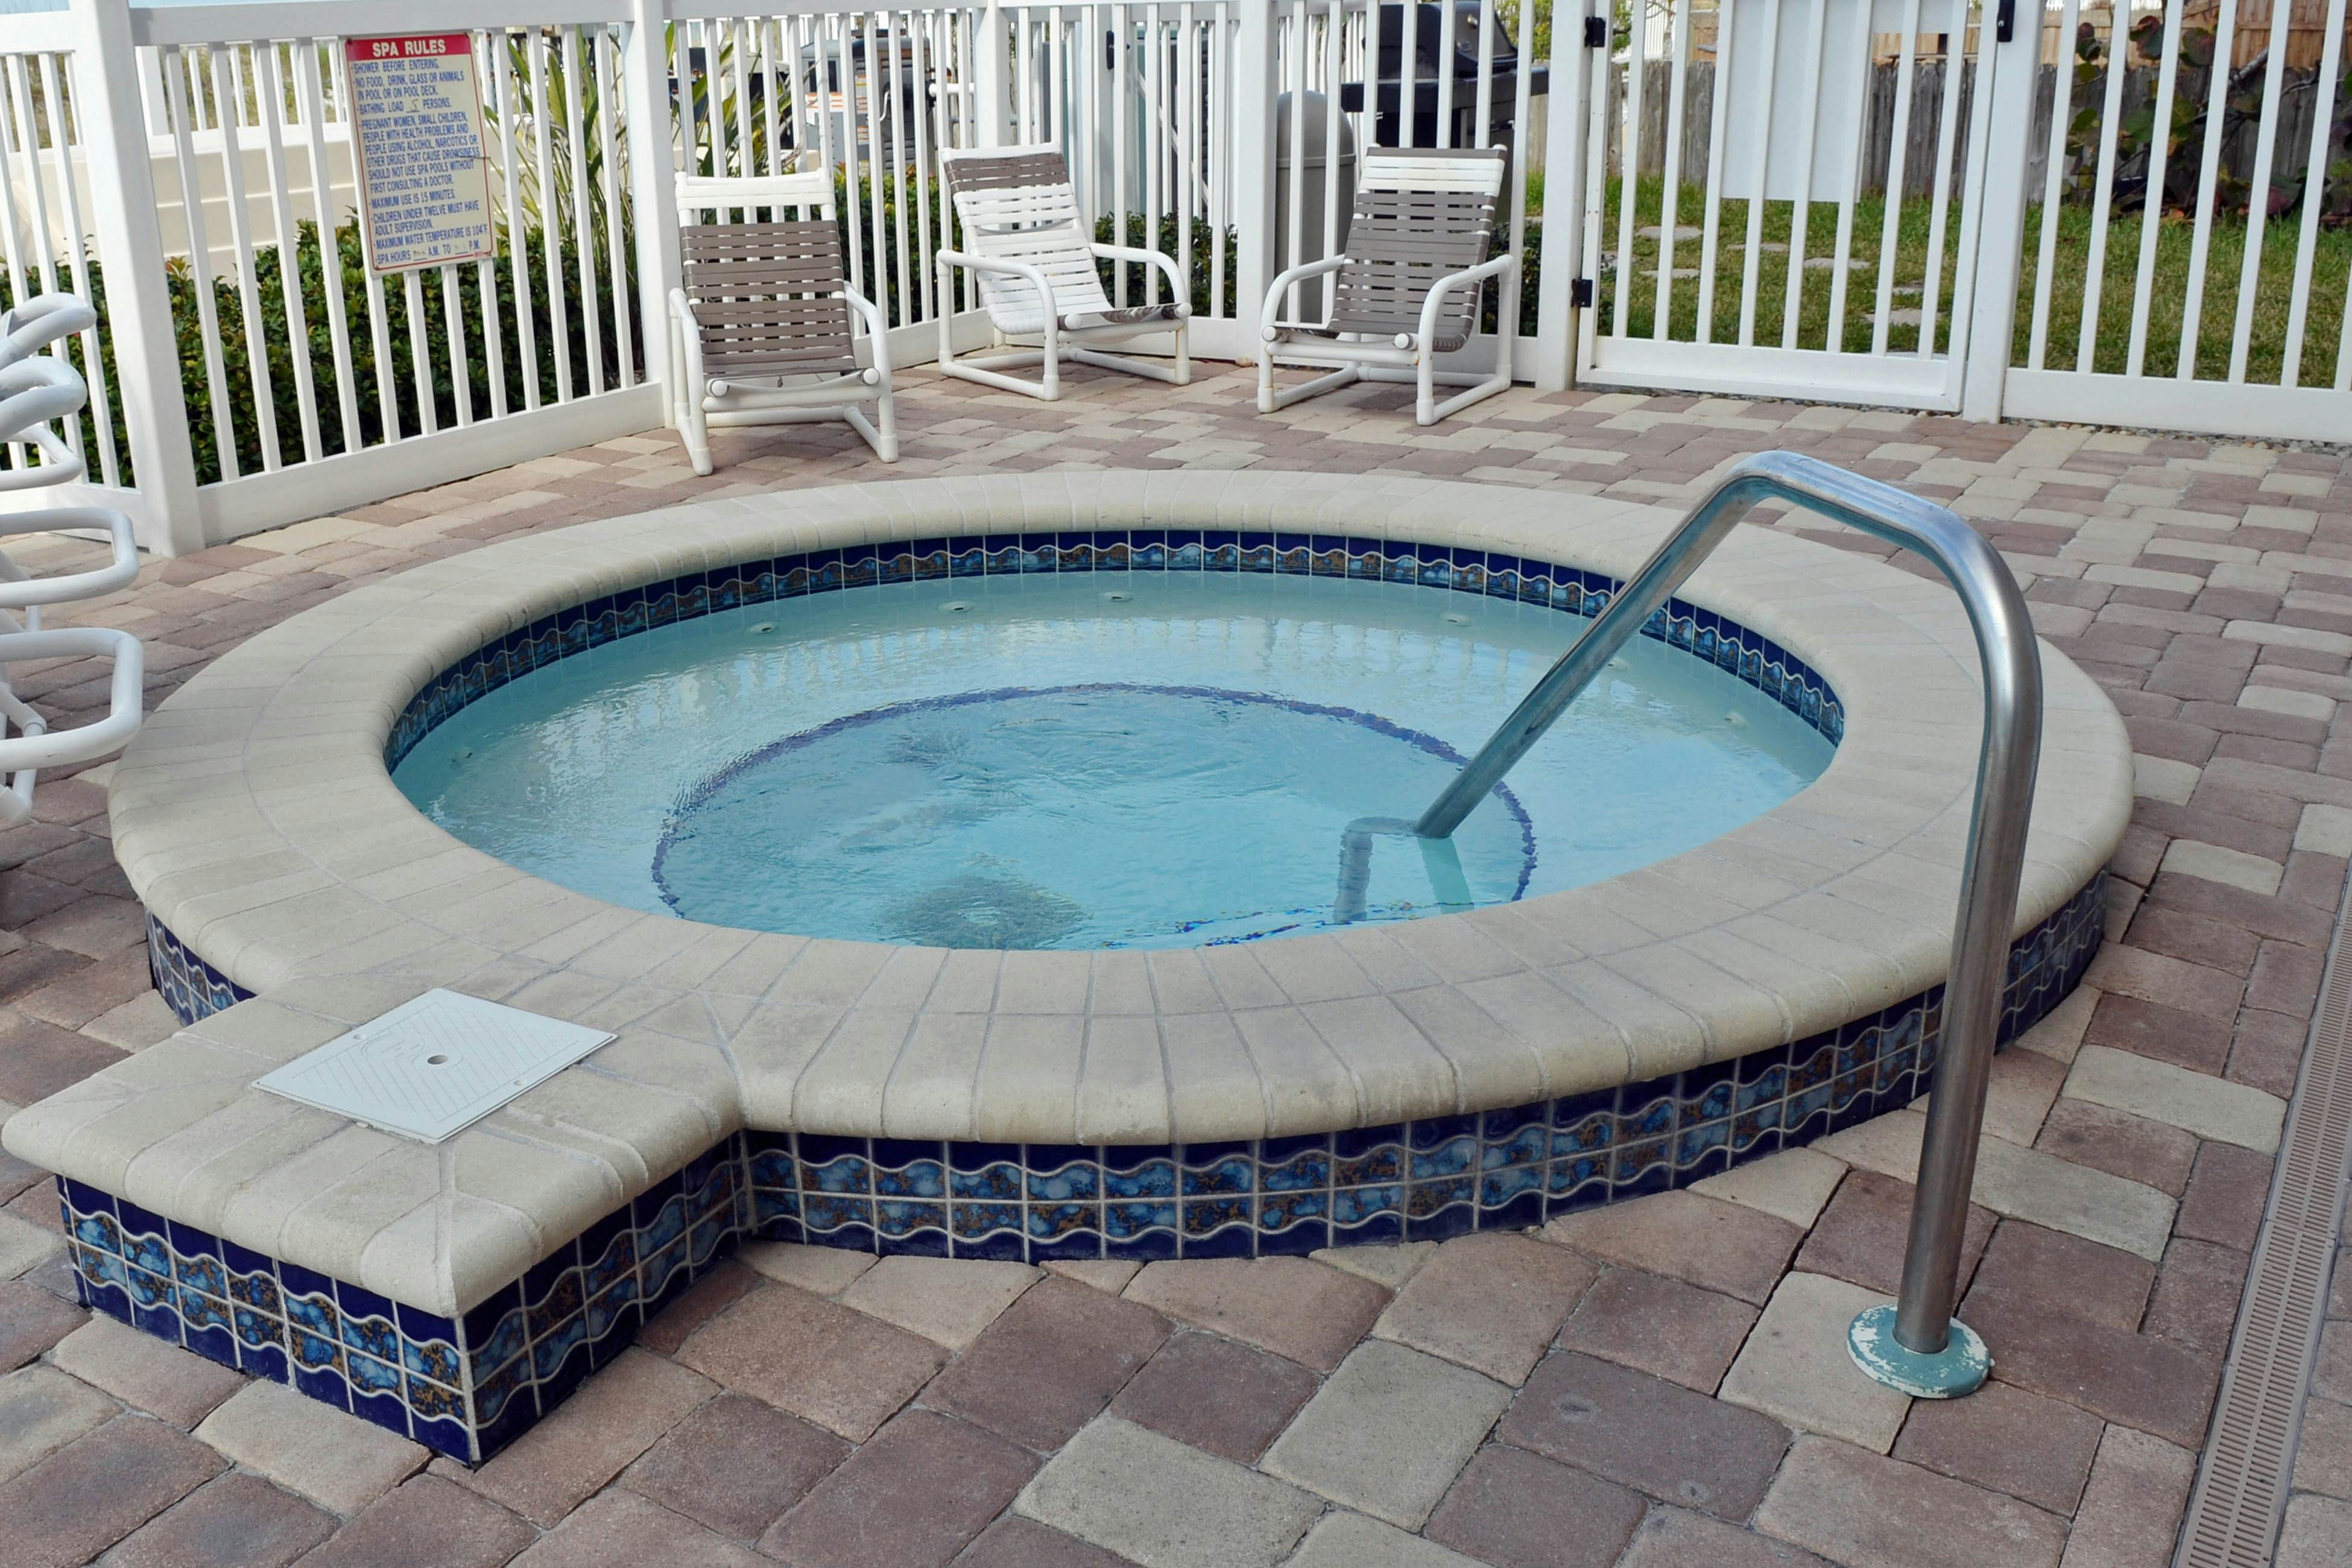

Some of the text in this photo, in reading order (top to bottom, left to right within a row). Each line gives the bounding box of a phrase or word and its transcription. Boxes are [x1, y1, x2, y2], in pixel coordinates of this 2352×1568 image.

[372, 39, 446, 57] SPA RULES
[354, 62, 379, 74] SHOWER
[383, 60, 405, 72] BEFORE
[356, 77, 365, 87] NO
[367, 75, 385, 87] FOOD,
[409, 72, 428, 84] GLASS
[429, 72, 437, 82] OR
[439, 71, 464, 82] ANIMALS
[357, 90, 364, 101] IN
[365, 89, 381, 100] POOL
[384, 88, 392, 98] OR
[393, 87, 402, 98] ON
[404, 86, 420, 97] POOL
[359, 103, 385, 115] BATHING
[388, 101, 404, 112] LOAD
[423, 98, 451, 110] PERSONS.
[362, 118, 391, 130] PREGNANT
[418, 113, 436, 125] SMALL
[363, 124, 469, 143] PEOPLE WITH HEALTH PROBLEMS AND
[365, 144, 387, 156] PEOPLE
[388, 142, 405, 153] USING
[435, 136, 467, 148] NARCOTICS
[469, 134, 477, 144] OR
[367, 147, 480, 168] OTHER DRUGS THAT CAUSE DROWSINESS
[368, 159, 474, 180] SHOULD NOT USE SPA POOLS WITHOUT
[370, 182, 386, 194] FIRST
[387, 179, 422, 192] CONSULTING
[424, 178, 428, 188] A
[371, 189, 456, 208] MAXIMUM USE IS 15 MINUTES.
[373, 200, 479, 224] CHILDREN UNDER TWELVE MUST HAVE
[375, 224, 393, 236] ADULT
[376, 237, 403, 249] MAXIMUM
[405, 233, 423, 245] WATER
[426, 227, 464, 242] TEMPERATURE
[466, 226, 471, 236] IS
[378, 253, 389, 265] SPA
[390, 250, 411, 262] HOURS
[443, 244, 451, 254] TO
